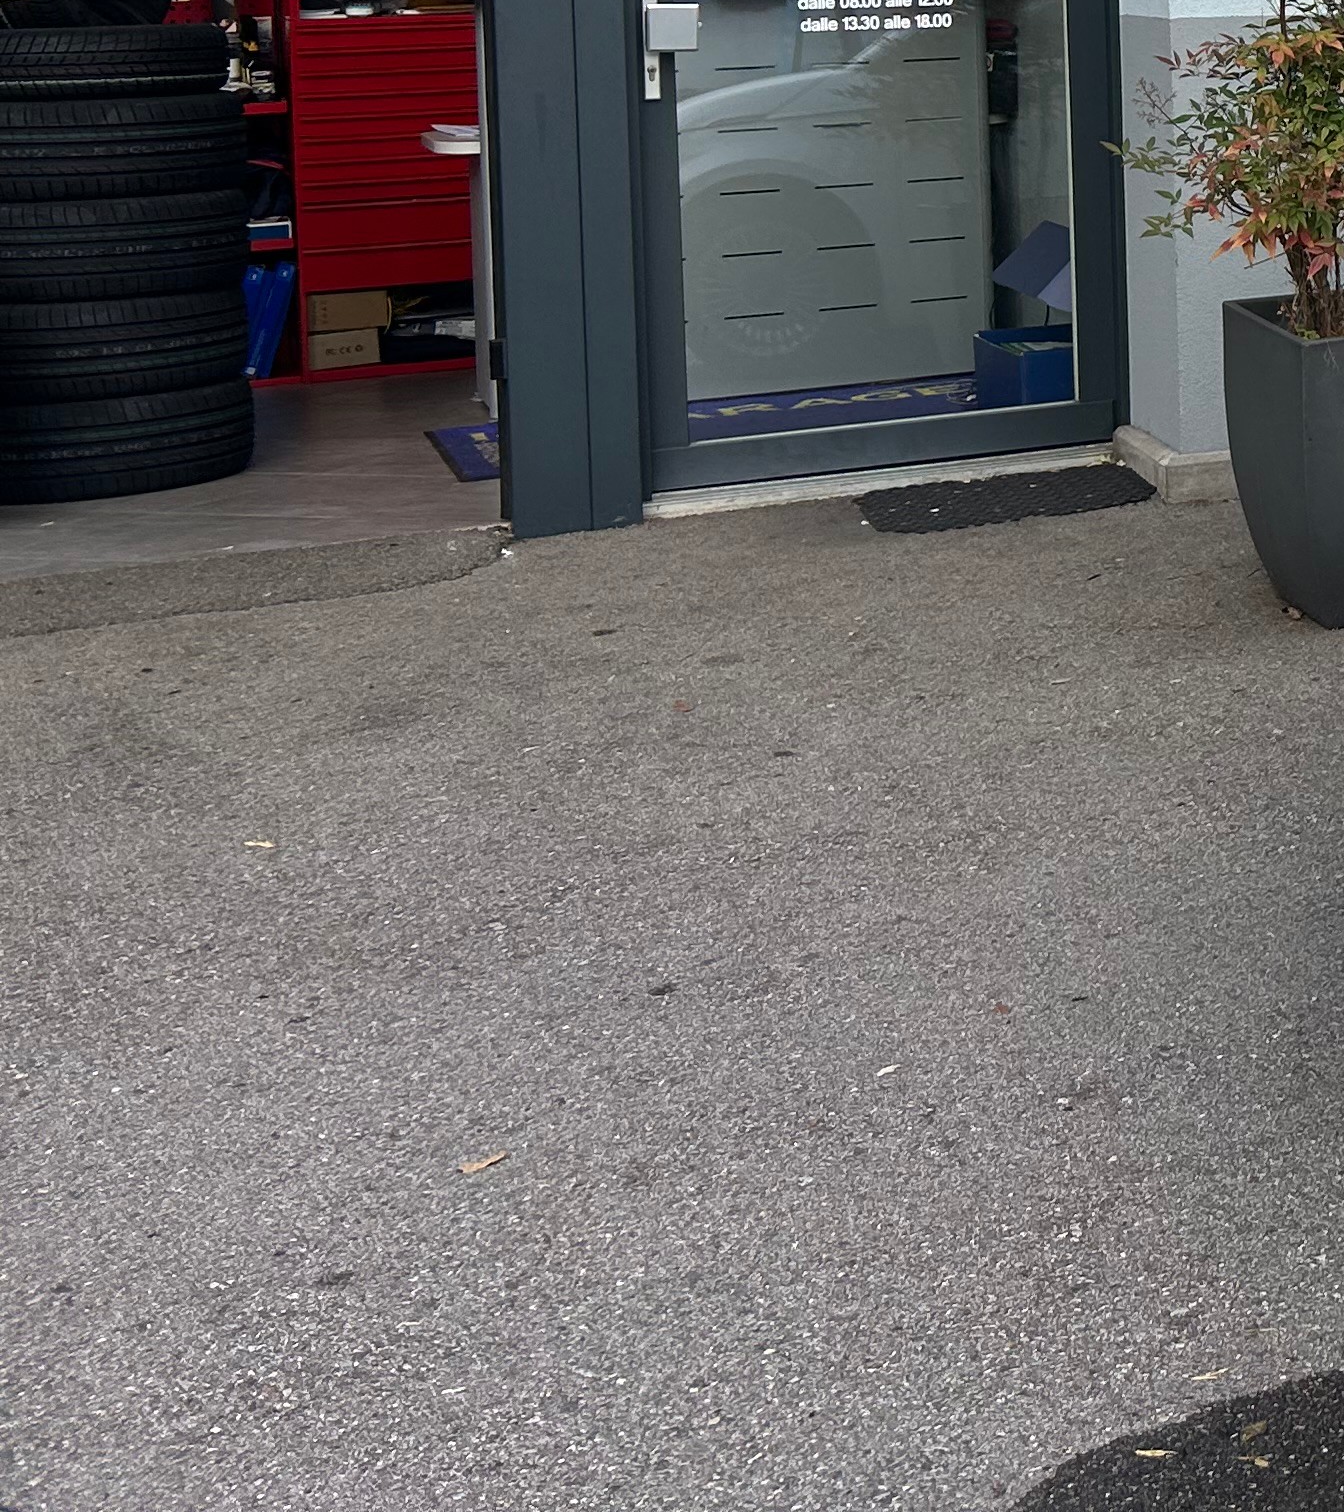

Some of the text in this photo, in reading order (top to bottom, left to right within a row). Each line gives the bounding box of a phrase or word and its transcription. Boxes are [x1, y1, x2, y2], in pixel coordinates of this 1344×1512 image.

[800, 13, 952, 32] dalle 13.30 alle 18.00
